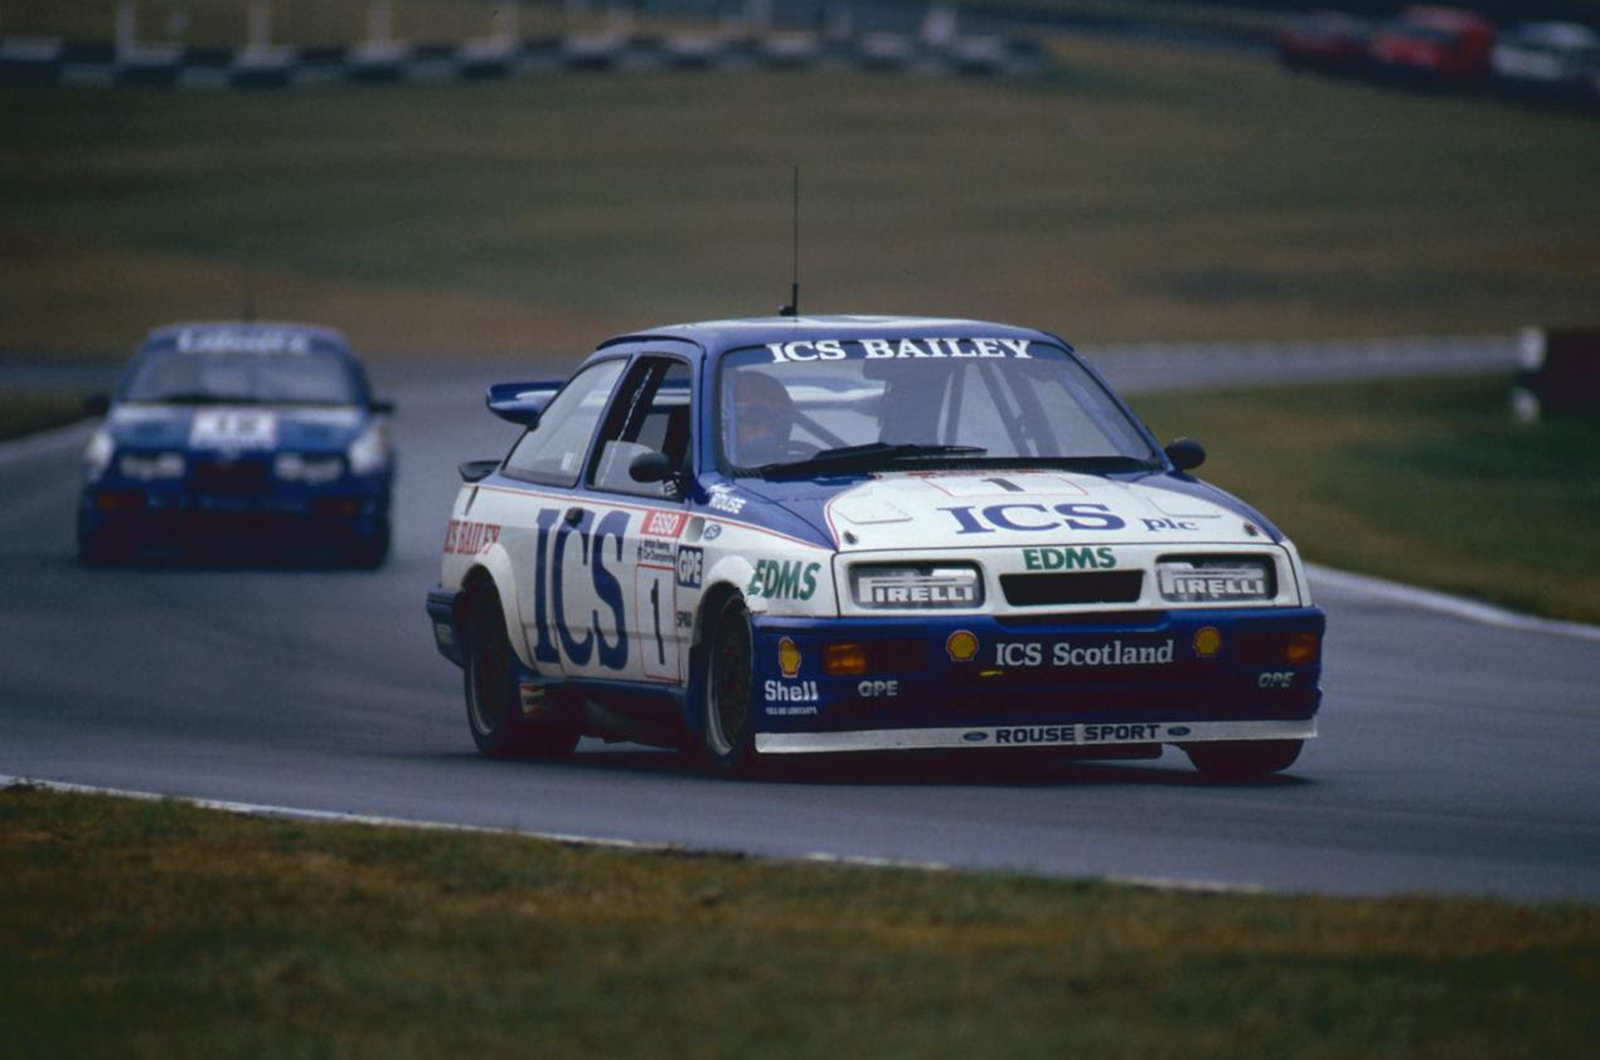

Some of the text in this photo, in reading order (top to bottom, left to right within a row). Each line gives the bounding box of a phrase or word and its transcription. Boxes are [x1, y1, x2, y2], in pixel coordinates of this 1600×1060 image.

[767, 338, 1033, 363] ICS BAILEY
[981, 477, 1026, 492] 1
[937, 504, 1199, 534] ICS plc
[679, 550, 702, 588] GPE
[1022, 547, 1117, 571] EDMS
[534, 508, 632, 671] ICS
[747, 559, 821, 601] EDMS
[858, 577, 974, 603] PIRELLI
[1160, 569, 1266, 595] PIRELLI
[651, 578, 666, 666] 1
[995, 640, 1175, 667] ICS Scotland
[764, 680, 819, 702] Shell
[858, 680, 898, 697] GPE
[996, 726, 1075, 744] ROUSE
[1083, 724, 1160, 741] SPORT
